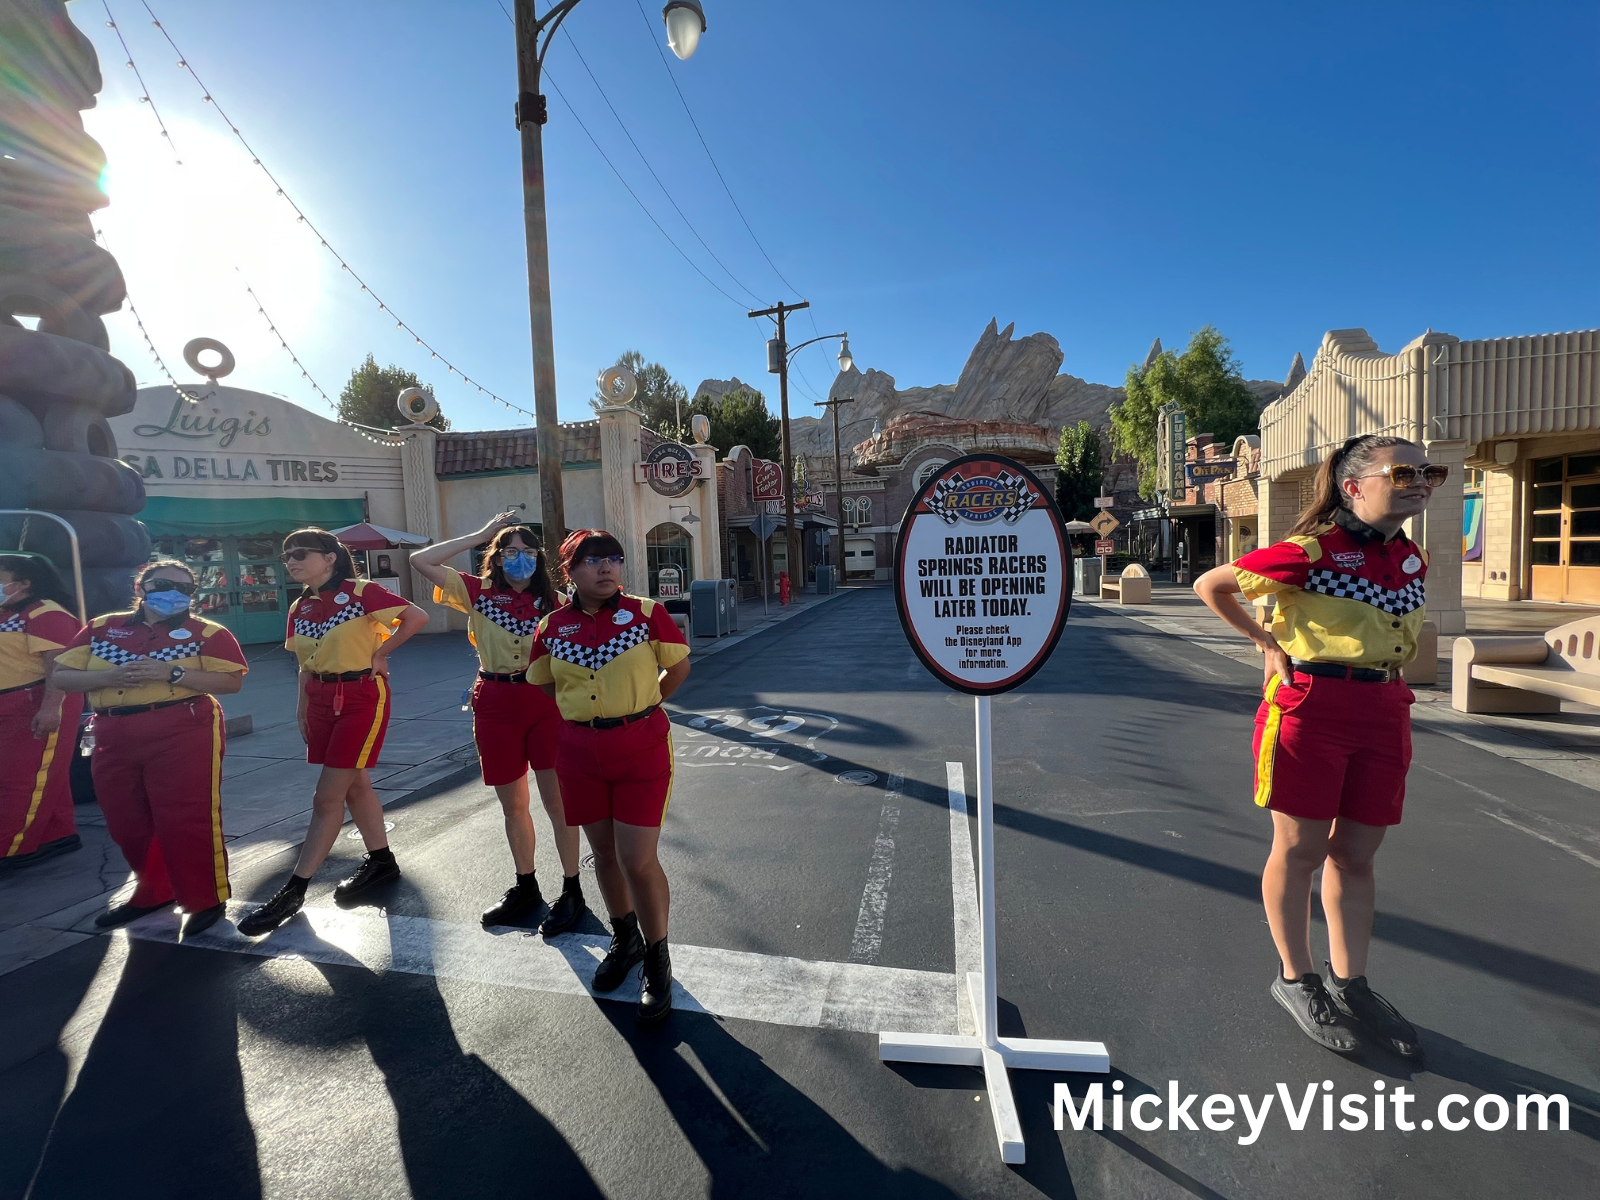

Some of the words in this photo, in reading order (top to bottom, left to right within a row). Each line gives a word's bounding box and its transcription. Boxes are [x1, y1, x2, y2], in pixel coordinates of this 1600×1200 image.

[121, 454, 164, 479] SA
[173, 456, 260, 481] DELLA
[266, 460, 339, 483] TIRES
[640, 460, 703, 480] TIRES
[755, 470, 776, 485] Curb
[962, 479, 998, 490] RADIATOR
[947, 492, 1015, 508] RACERS
[964, 510, 998, 519] SPRINGS
[945, 535, 1018, 555] RADIATOR
[918, 557, 983, 577] SPRINGS
[988, 555, 1047, 575] RACERS
[660, 585, 679, 597] SALE
[919, 579, 953, 598] WILL
[958, 578, 976, 597] BE
[981, 576, 1046, 596] OPENING
[934, 599, 976, 618] LATER
[981, 598, 1031, 617] TODAY.
[956, 625, 983, 635] Please
[985, 624, 1010, 635] check
[945, 637, 958, 647] the
[960, 636, 1004, 648] Disneyland
[1006, 635, 1022, 647] App
[965, 647, 978, 657] for
[980, 648, 1002, 657] more
[958, 659, 1009, 669] information.
[674, 745, 780, 760] ROUT
